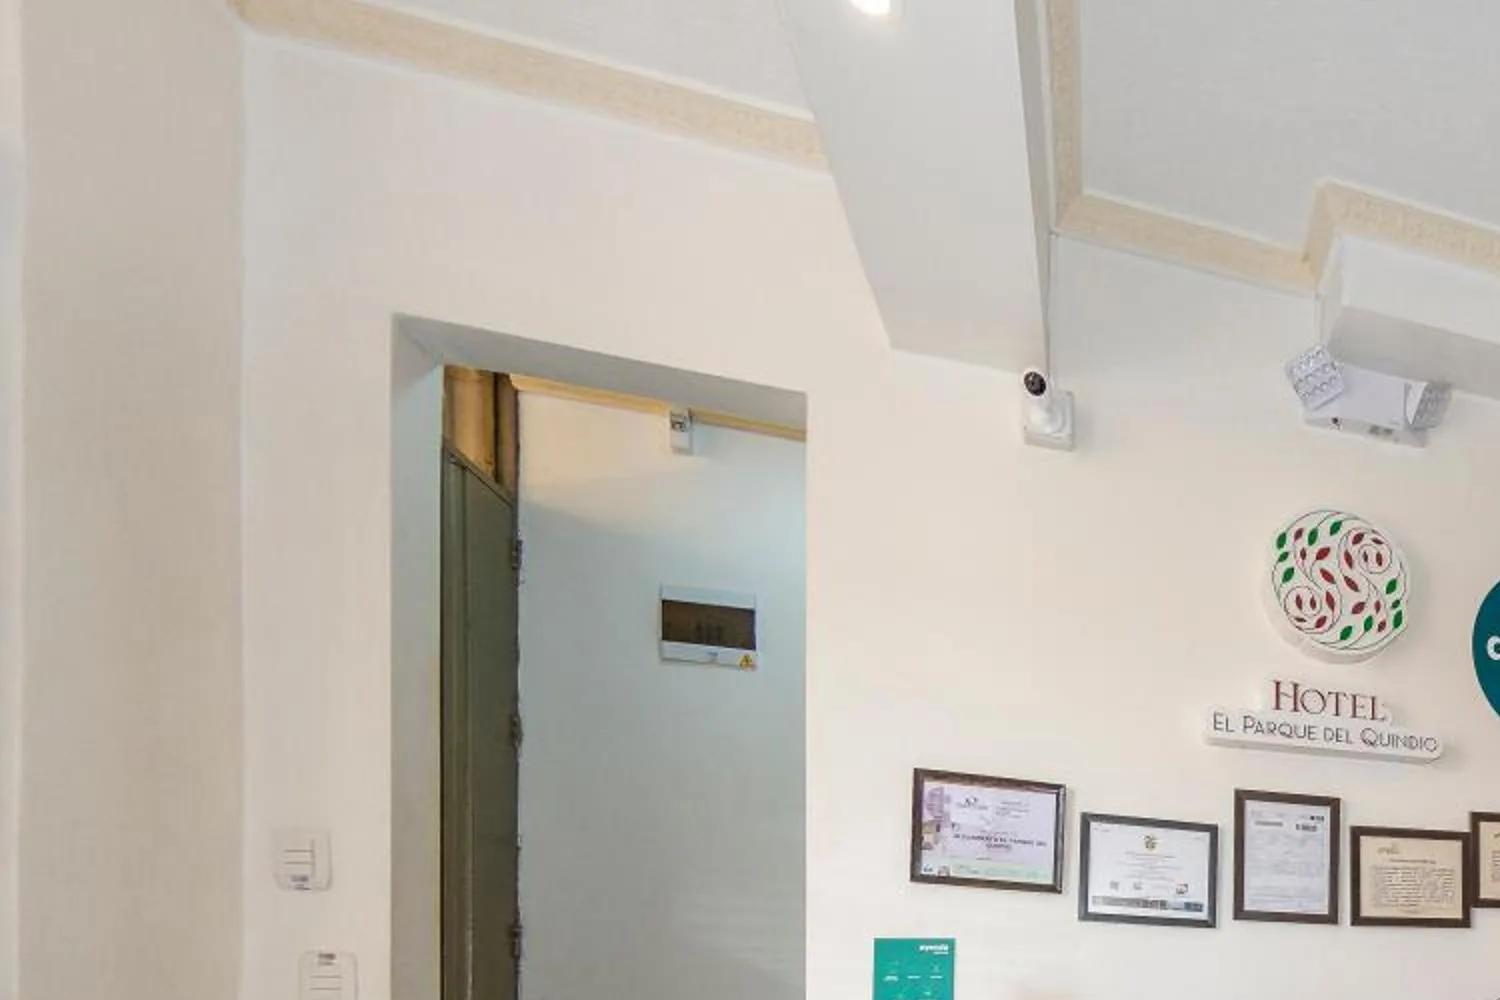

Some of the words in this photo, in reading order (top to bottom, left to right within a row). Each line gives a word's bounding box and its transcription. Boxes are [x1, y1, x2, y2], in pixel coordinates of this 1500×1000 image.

[1272, 679, 1387, 722] HOTEL
[1212, 711, 1235, 734] EL
[1242, 714, 1317, 741] PARQUE
[1323, 726, 1355, 745] DEL
